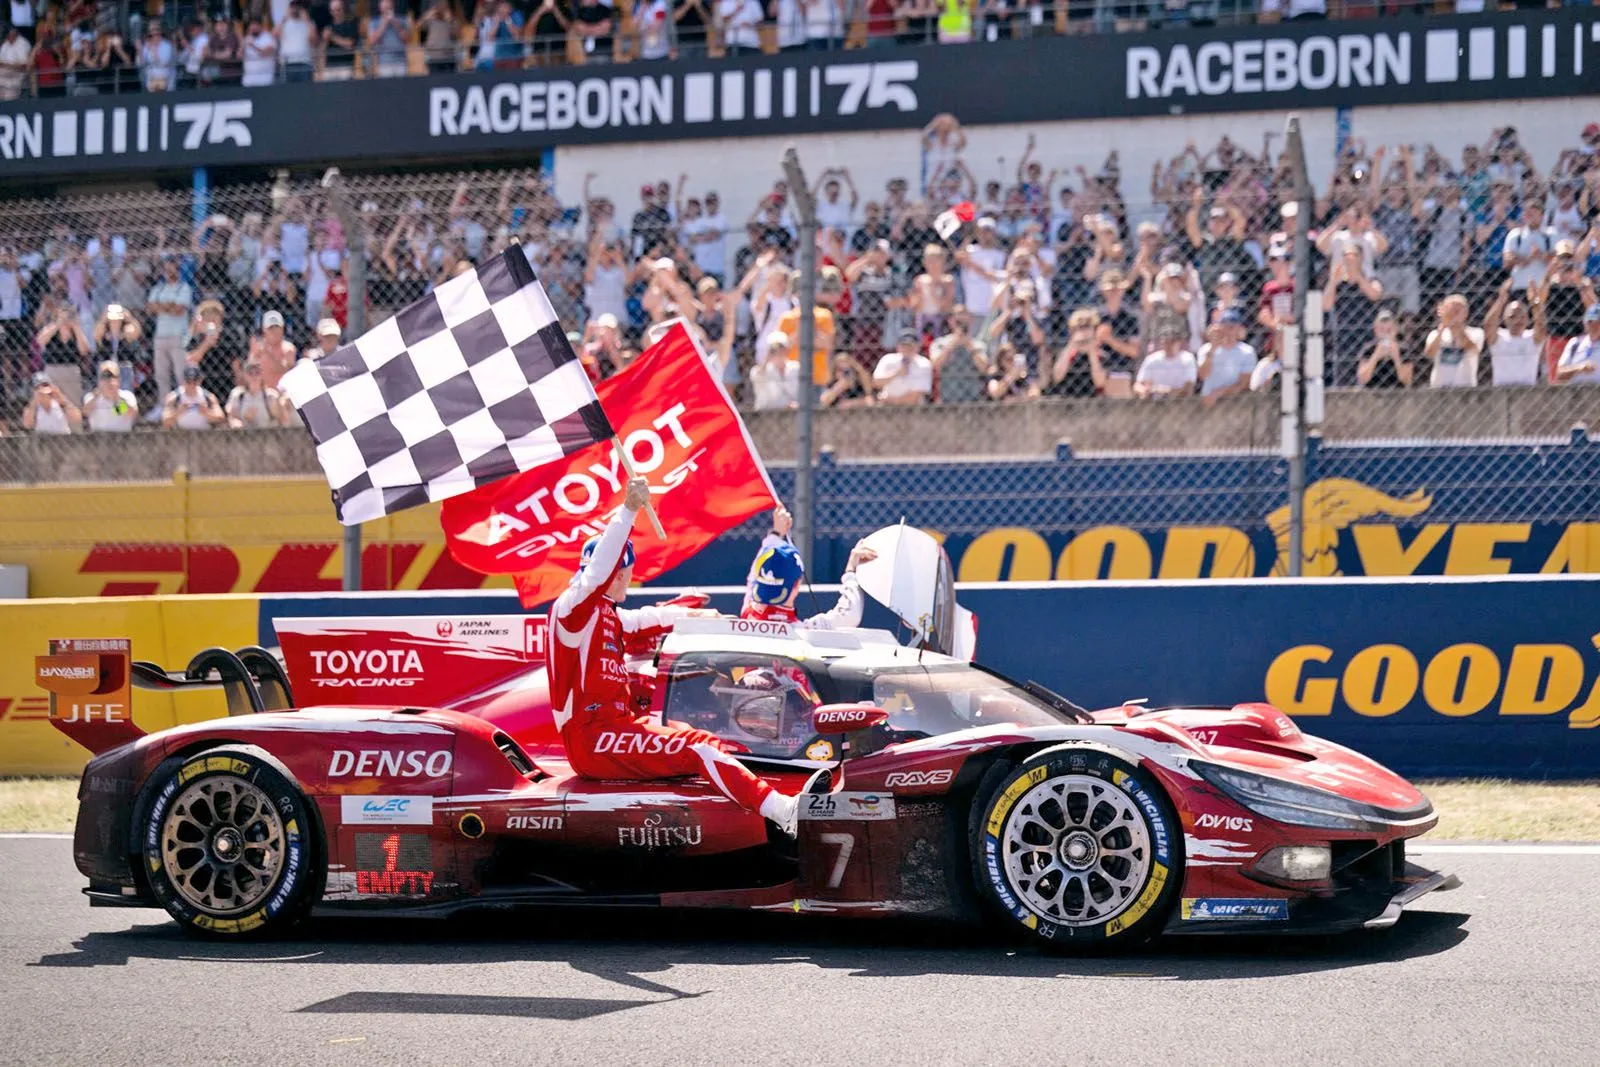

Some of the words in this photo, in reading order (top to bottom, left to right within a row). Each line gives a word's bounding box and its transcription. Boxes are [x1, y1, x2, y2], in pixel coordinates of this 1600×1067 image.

[1127, 32, 1411, 99] RACEBORN
[429, 75, 674, 136] RACEBORN
[824, 61, 918, 115] 75
[174, 101, 253, 149] 75
[730, 620, 788, 635] TOYOTA
[310, 650, 424, 674] TOYOTA
[311, 677, 424, 687] RACING
[62, 703, 125, 723] JFE
[818, 710, 867, 724] DENSO
[594, 732, 687, 754] DENSO
[328, 750, 453, 778] DENSO
[885, 769, 953, 787] RAYS
[363, 799, 411, 812] WEC
[506, 816, 563, 830] AISIN
[617, 815, 701, 850] FUJITSU
[1194, 813, 1253, 832] ADVICS
[382, 833, 400, 872] 1
[820, 832, 855, 889] 7
[356, 871, 435, 894] EMPTY
